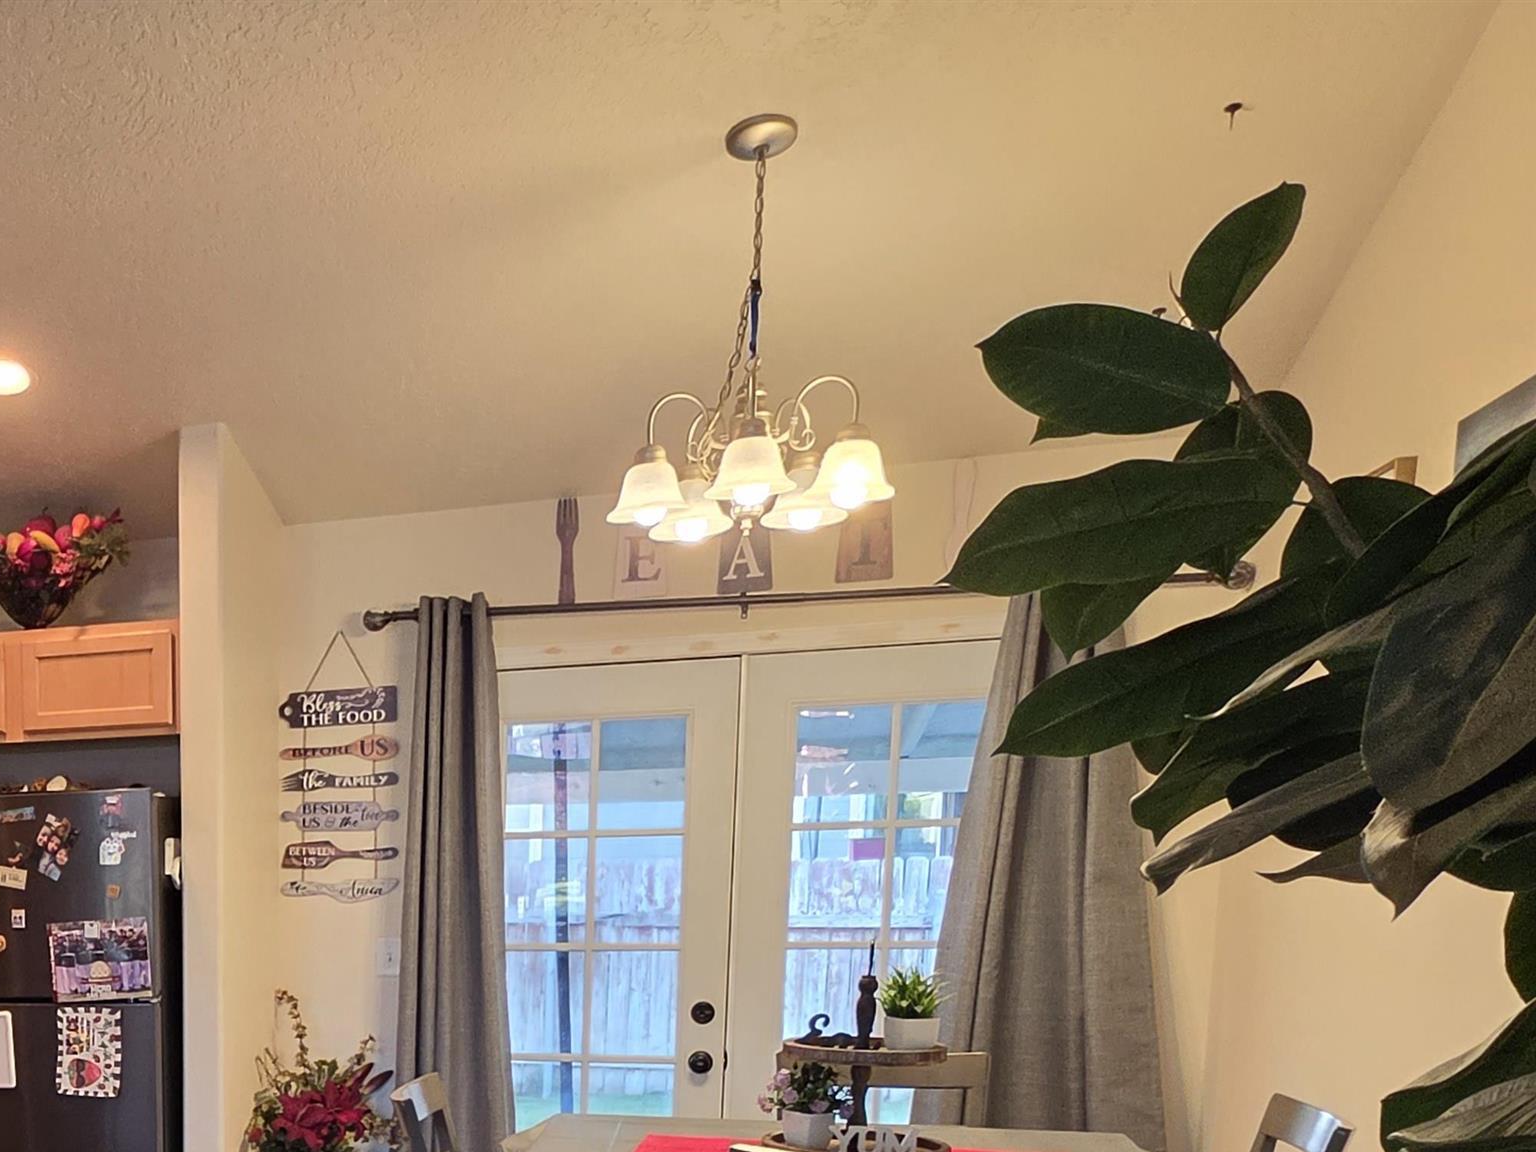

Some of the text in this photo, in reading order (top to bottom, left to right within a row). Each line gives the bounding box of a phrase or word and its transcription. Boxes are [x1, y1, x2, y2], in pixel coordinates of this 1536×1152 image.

[297, 693, 343, 714] Bless
[300, 708, 387, 727] THE FOOD
[360, 737, 389, 757] US
[299, 770, 389, 790] the FAMILY
[302, 802, 354, 815] BESIDE
[302, 817, 321, 829] US
[339, 815, 360, 829] the
[289, 846, 337, 857] BETWEEN
[303, 856, 317, 867] US
